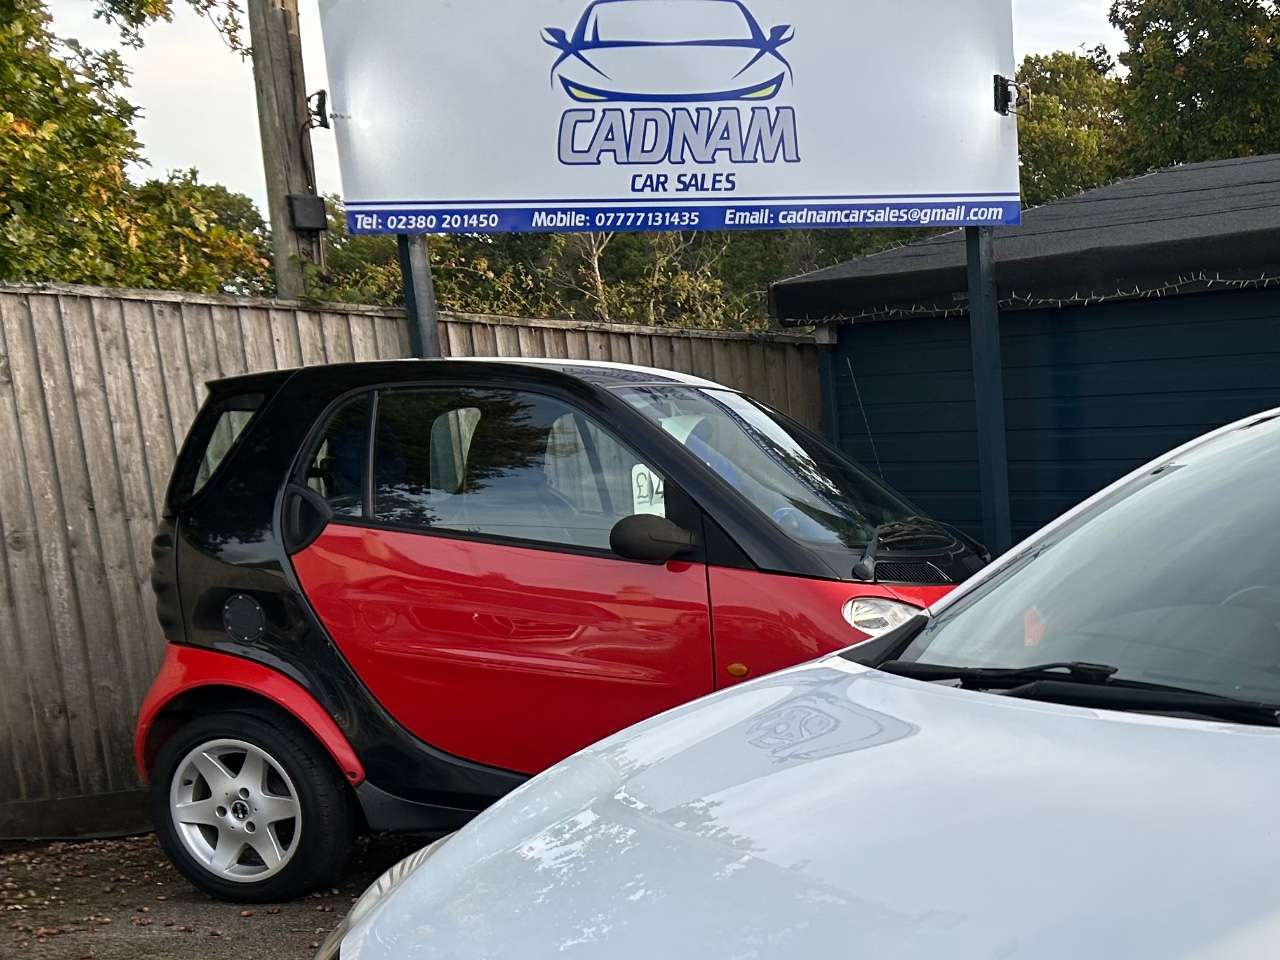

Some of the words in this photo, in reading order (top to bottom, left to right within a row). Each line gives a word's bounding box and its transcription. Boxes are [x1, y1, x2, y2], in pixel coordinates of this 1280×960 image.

[557, 106, 801, 165] CADNAM
[631, 174, 668, 192] CAR
[675, 173, 736, 192] SALES
[355, 214, 382, 229] Tel:
[387, 215, 436, 230] 02380
[442, 213, 499, 228] 201450
[532, 211, 590, 228] Mobile:
[595, 211, 700, 227] 07777131435
[724, 209, 774, 225] Email:
[778, 205, 1003, 225] cadnamcarsales@gmail.com
